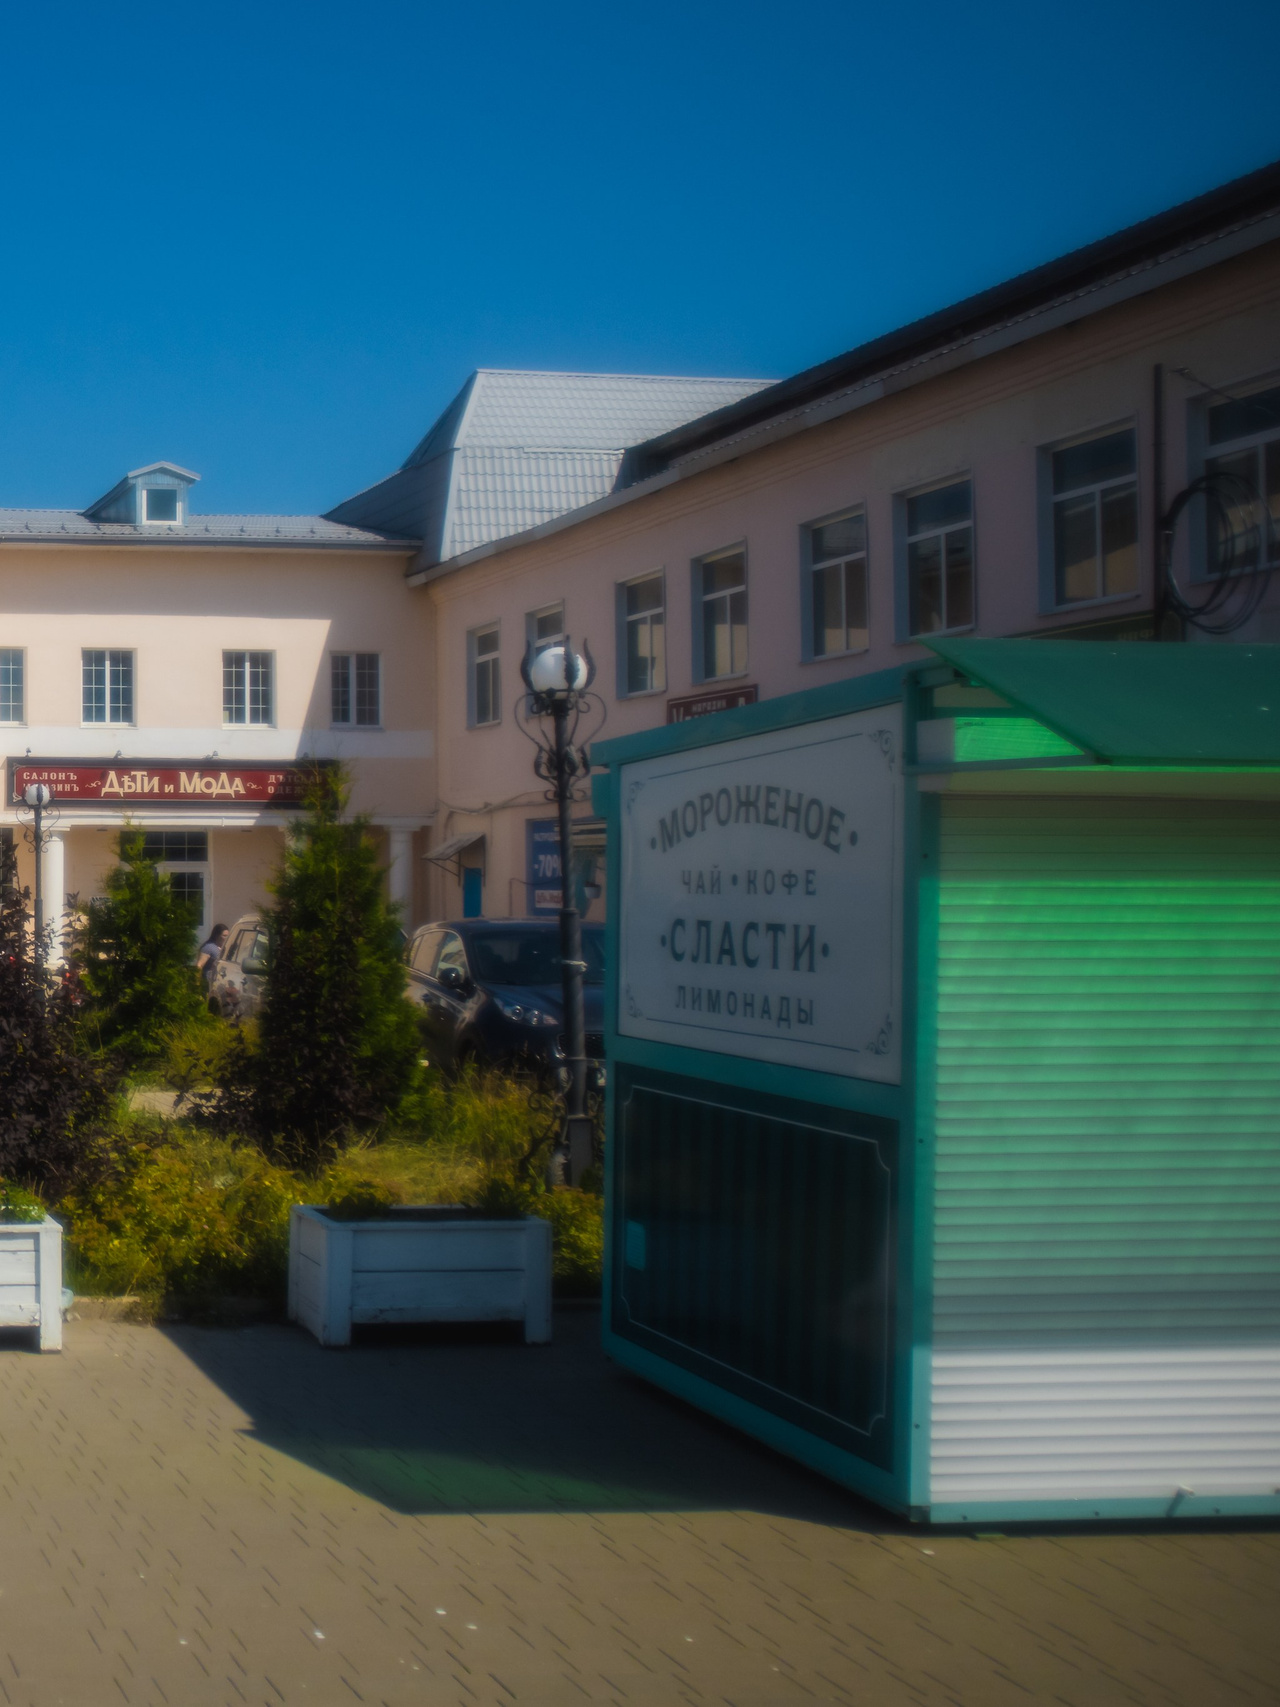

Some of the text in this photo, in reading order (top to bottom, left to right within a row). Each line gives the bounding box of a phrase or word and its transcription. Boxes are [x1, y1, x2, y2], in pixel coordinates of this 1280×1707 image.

[23, 772, 78, 781] САЛОНЪ
[658, 784, 846, 854] МОРОЖЕНОЕ
[681, 865, 817, 897] ЧАЙ КОФЕ
[669, 917, 817, 973] СЛАСТИ
[675, 984, 815, 1030] ЛИМОНАДЫ
